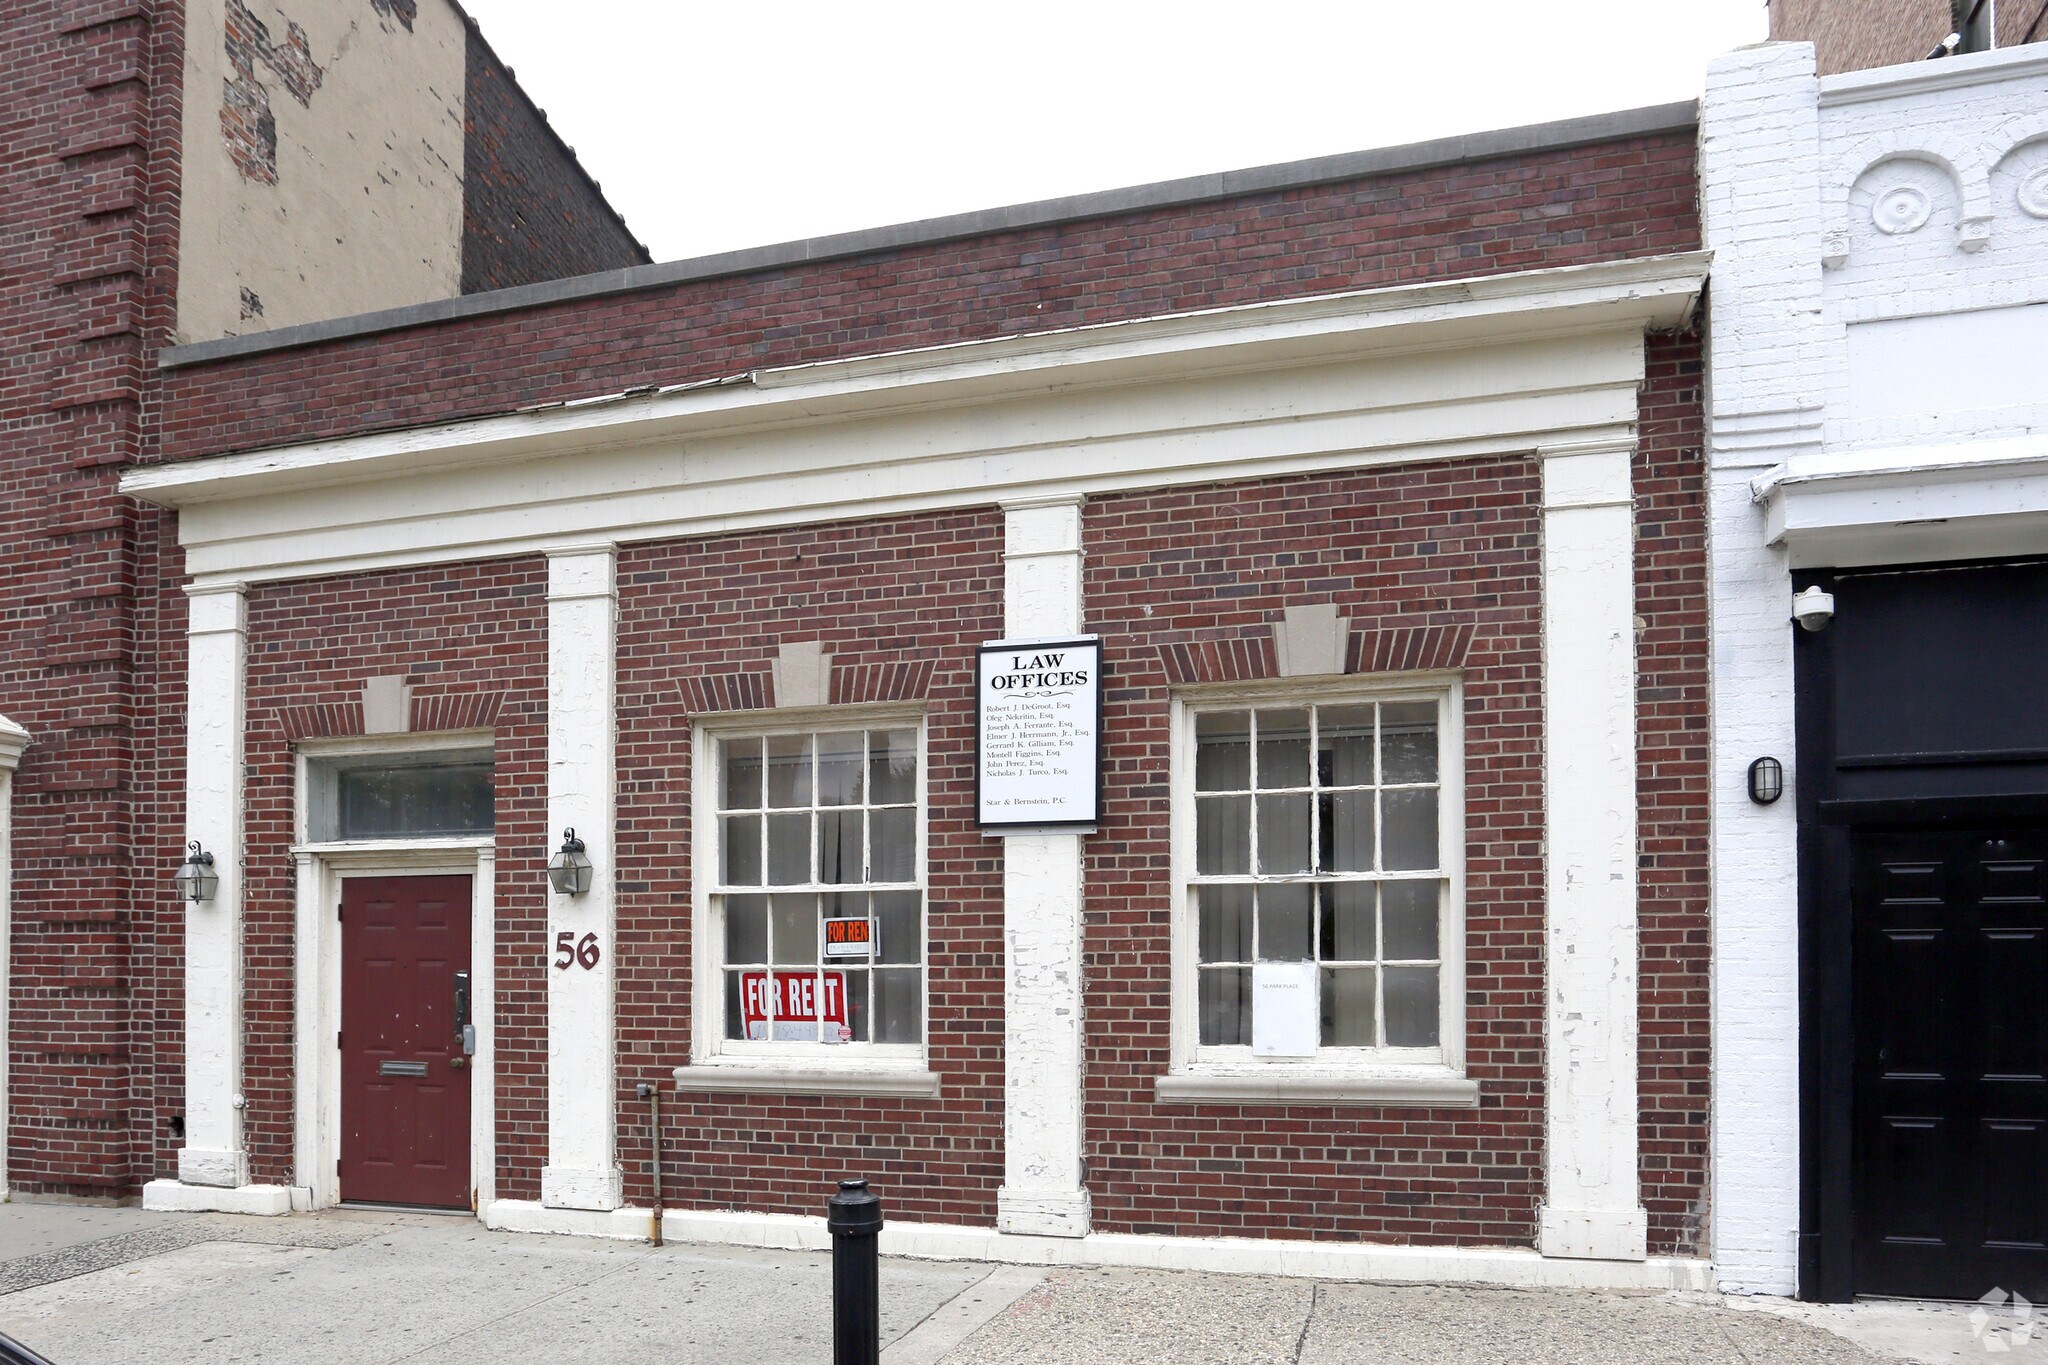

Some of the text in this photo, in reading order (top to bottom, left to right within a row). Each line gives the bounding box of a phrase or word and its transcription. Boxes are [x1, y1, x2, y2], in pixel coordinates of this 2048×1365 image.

[1012, 653, 1065, 671] LAW
[991, 671, 1088, 689] OFFICES
[986, 702, 1072, 713] Robert J. DeGroot, Esq.
[1039, 712, 1055, 720] Esq.
[986, 723, 1010, 732] Joseph
[1024, 721, 1056, 729] Ferrante,
[1058, 720, 1075, 728] Esq.
[1011, 732, 1017, 740] J.
[1019, 731, 1059, 739] Herrmann,
[1075, 729, 1091, 737] Esq.
[986, 742, 1014, 750] Gerrard
[1059, 739, 1075, 747] Esq.
[1015, 750, 1044, 758] Figgins,
[1046, 749, 1062, 757] Esq.
[986, 759, 1045, 769] John Perez, Esq.
[1019, 769, 1025, 777] J.
[1028, 768, 1051, 776] Turco,
[1053, 767, 1069, 775] Esq.
[986, 798, 1001, 806] Star
[828, 920, 869, 942] FOR REN
[554, 932, 600, 971] 56
[748, 978, 838, 1016] FOR RENT
